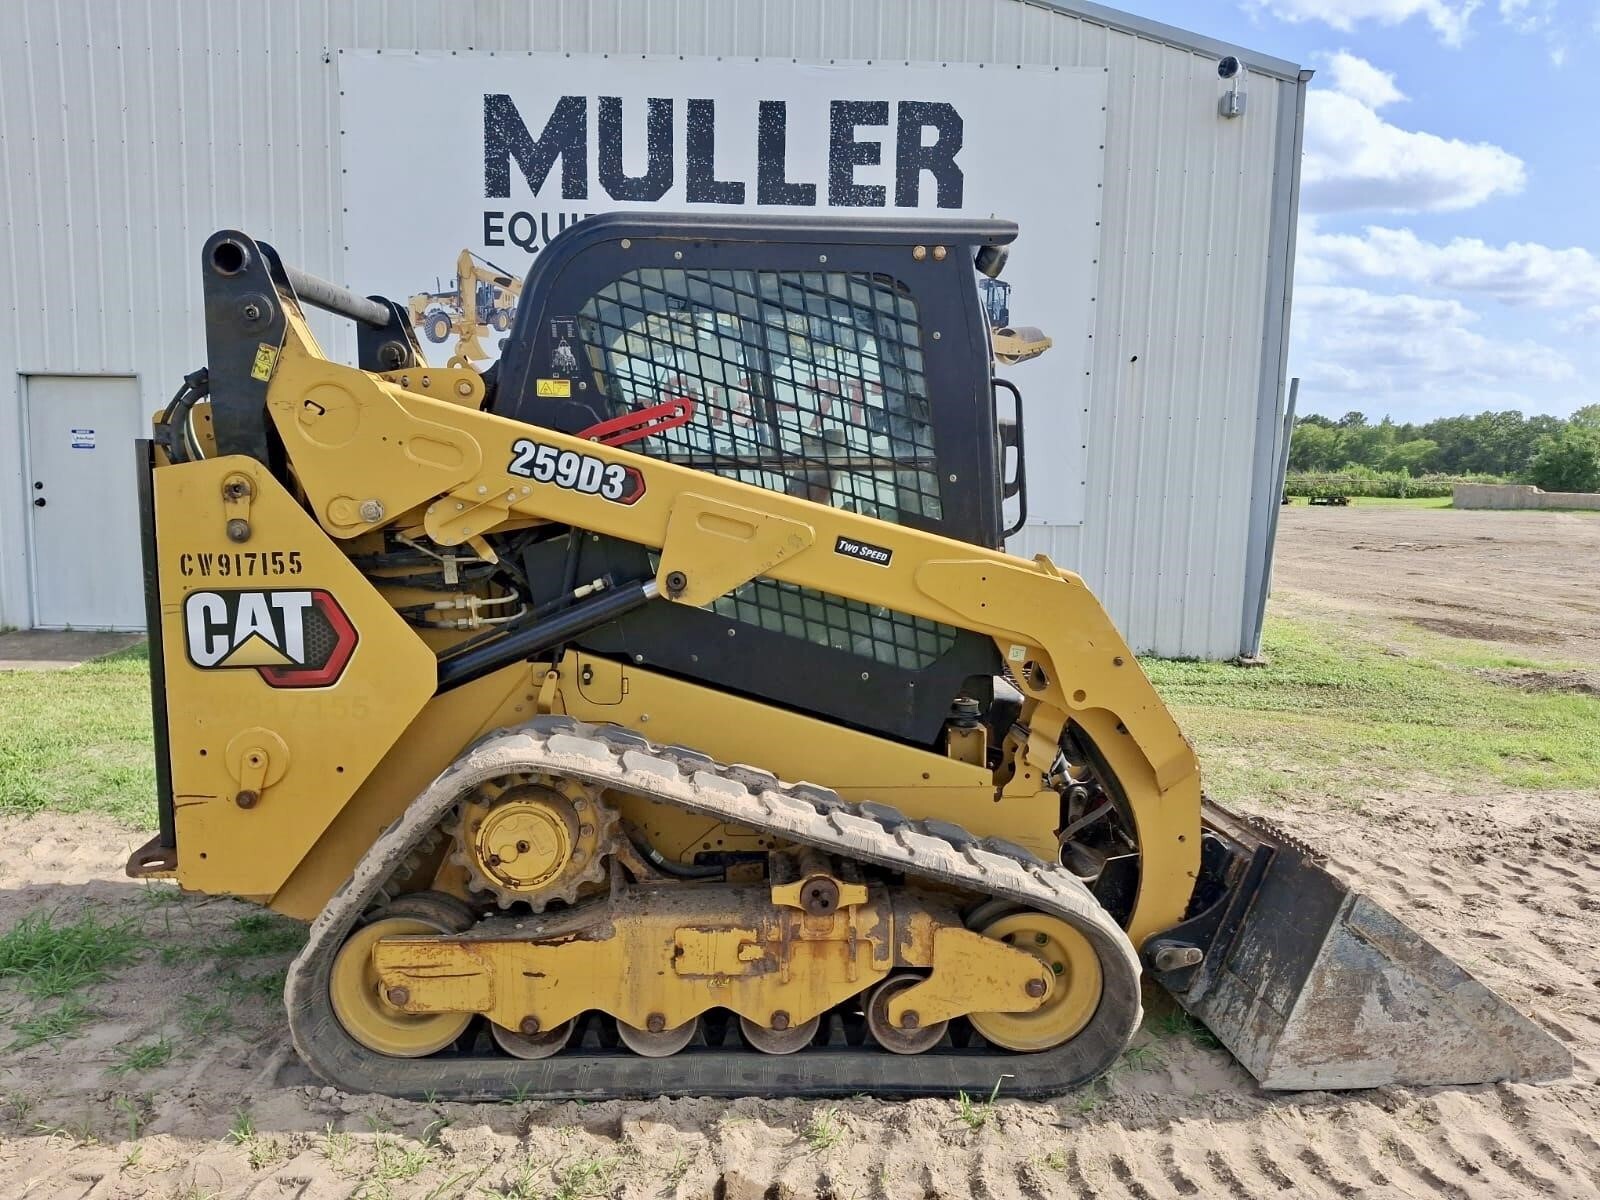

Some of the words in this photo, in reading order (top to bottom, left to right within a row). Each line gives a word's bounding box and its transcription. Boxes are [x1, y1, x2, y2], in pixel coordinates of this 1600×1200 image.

[484, 94, 964, 209] MULLER
[508, 439, 627, 500] 259D3
[180, 551, 303, 577] CW917155
[186, 592, 313, 667] CAT
